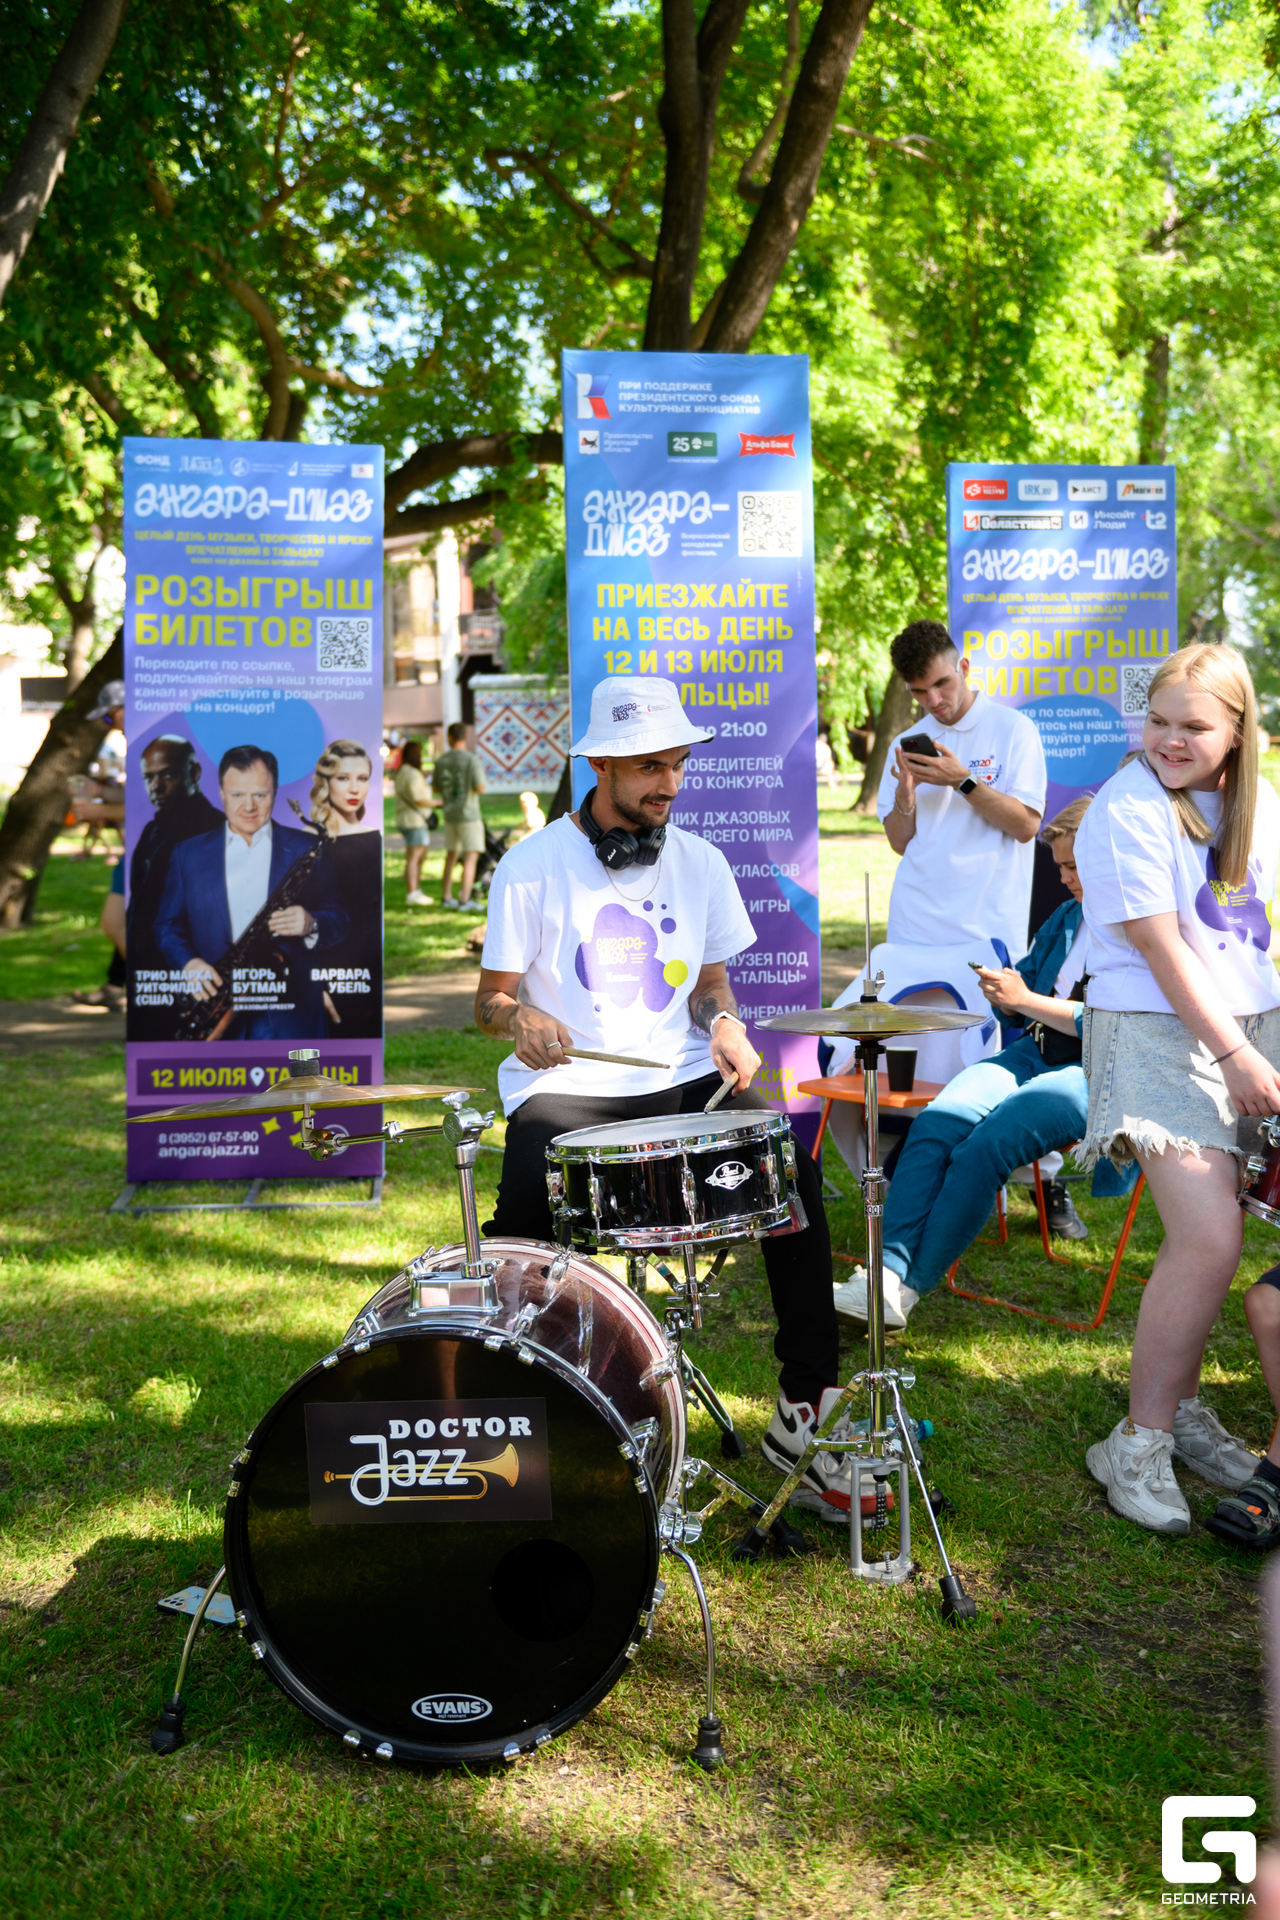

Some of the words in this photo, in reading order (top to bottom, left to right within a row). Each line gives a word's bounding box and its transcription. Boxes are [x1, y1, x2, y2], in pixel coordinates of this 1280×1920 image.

[618, 381, 641, 390] ПРИ
[644, 382, 713, 392] ПОДДЕРЖКЕ
[618, 392, 717, 403] ПРЕЗИДЕНТСКОГО
[719, 394, 761, 405] ФОНДА
[618, 403, 691, 413] КУЛЬТУРНЫХ
[694, 404, 761, 415] ИНИЦИАТИВ
[672, 437, 690, 452] 25
[134, 454, 171, 467] ФОНД
[1081, 486, 1102, 494] АИСТ
[1094, 510, 1136, 520] Инсайт
[1146, 509, 1167, 530] t2
[1094, 520, 1127, 531] Люди
[135, 529, 174, 542] ЦЕЛЫЙ
[176, 531, 206, 543] ДЕНЬ
[208, 532, 257, 544] МУЗЫКИ,
[259, 533, 326, 545] ТВОРЧЕСТВА
[328, 534, 336, 544] И
[338, 535, 373, 546] ЯРКИХ
[186, 545, 261, 556] ВПЕЧАТЛЕНИЙ
[263, 547, 270, 556] В
[273, 547, 324, 558] ТАЛЬЦАХ!
[135, 574, 373, 610] РОЗЫГРЫШ
[597, 578, 789, 608] ПРИЕЗЖАЙТЕ
[963, 591, 997, 603] ЦЕЛЫЙ
[998, 591, 1025, 603] ДЕНЬ
[1026, 591, 1069, 603] МУЗЫКИ,
[1070, 591, 1129, 602] ТВОРЧЕСТВА
[1131, 591, 1138, 601] И
[1139, 591, 1170, 601] ЯРКИХ
[1007, 604, 1073, 614] ВПЕЧАТЛЕНИЙ
[1074, 605, 1081, 614] В
[1082, 604, 1128, 614] ТАЛЬЦАХ!
[135, 613, 313, 648] БИЛЕТОВ
[593, 616, 631, 641] НА
[638, 616, 711, 641] ВЕСЬ
[717, 616, 793, 645] ДЕНЬ
[963, 628, 1169, 660] РОЗЫГРЫШ
[135, 656, 218, 671] Переходите
[222, 660, 239, 672] по
[242, 660, 296, 673] ссылке,
[603, 650, 632, 674] 12
[639, 650, 658, 673] И
[664, 650, 694, 673] 13
[700, 649, 783, 673] ИЮЛЯ
[135, 673, 254, 685] подписывайтесь
[257, 675, 272, 685] на
[276, 675, 306, 686] наш
[309, 675, 373, 689] телеграм
[966, 664, 1118, 696] БИЛЕТОВ
[135, 688, 176, 698] канал
[179, 688, 188, 698] и
[191, 687, 270, 702] участвуйте
[273, 690, 281, 699] в
[284, 690, 365, 702] розыгрыше
[135, 700, 192, 713] билетов
[195, 702, 212, 713] на
[215, 702, 276, 715] концерт!
[1038, 709, 1054, 718] по
[1056, 708, 1103, 718] ссылке,
[720, 721, 768, 737] 21:00
[1069, 721, 1084, 731] на
[1087, 721, 1112, 730] наш
[1083, 734, 1091, 743] в
[968, 759, 991, 768] 2020
[706, 775, 784, 790] КОНКУРСА
[702, 811, 790, 828] ДЖАЗОВЫХ
[703, 828, 750, 843] ВСЕГО
[753, 828, 794, 842] МИРА
[749, 899, 791, 913] ИГРЫ
[725, 952, 773, 967] МУЗЕЯ
[776, 951, 809, 968] ПОД
[136, 970, 168, 982] ТРИО
[169, 970, 213, 981] МАРКА
[233, 968, 277, 981] ИГОРЬ
[311, 968, 371, 981] ВАРВАРА
[733, 969, 807, 986] «ТАЛЬЦЫ»
[136, 982, 204, 995] УИТФИЛДА
[233, 981, 287, 994] БУТМАН
[329, 981, 371, 994] УБЕЛЬ
[136, 994, 175, 1006] (США)
[151, 1069, 174, 1088] 12
[179, 1067, 247, 1087] ИЮЛЯ
[266, 1066, 358, 1085] ТАЫ
[159, 1133, 167, 1144] 8
[169, 1132, 206, 1145] (3952)
[208, 1131, 259, 1143] 67-57-90
[159, 1143, 259, 1159] angarajazz.ru
[389, 1416, 532, 1439] DOCTOR
[350, 1434, 469, 1506] Jazz
[421, 1701, 482, 1714] EVANS
